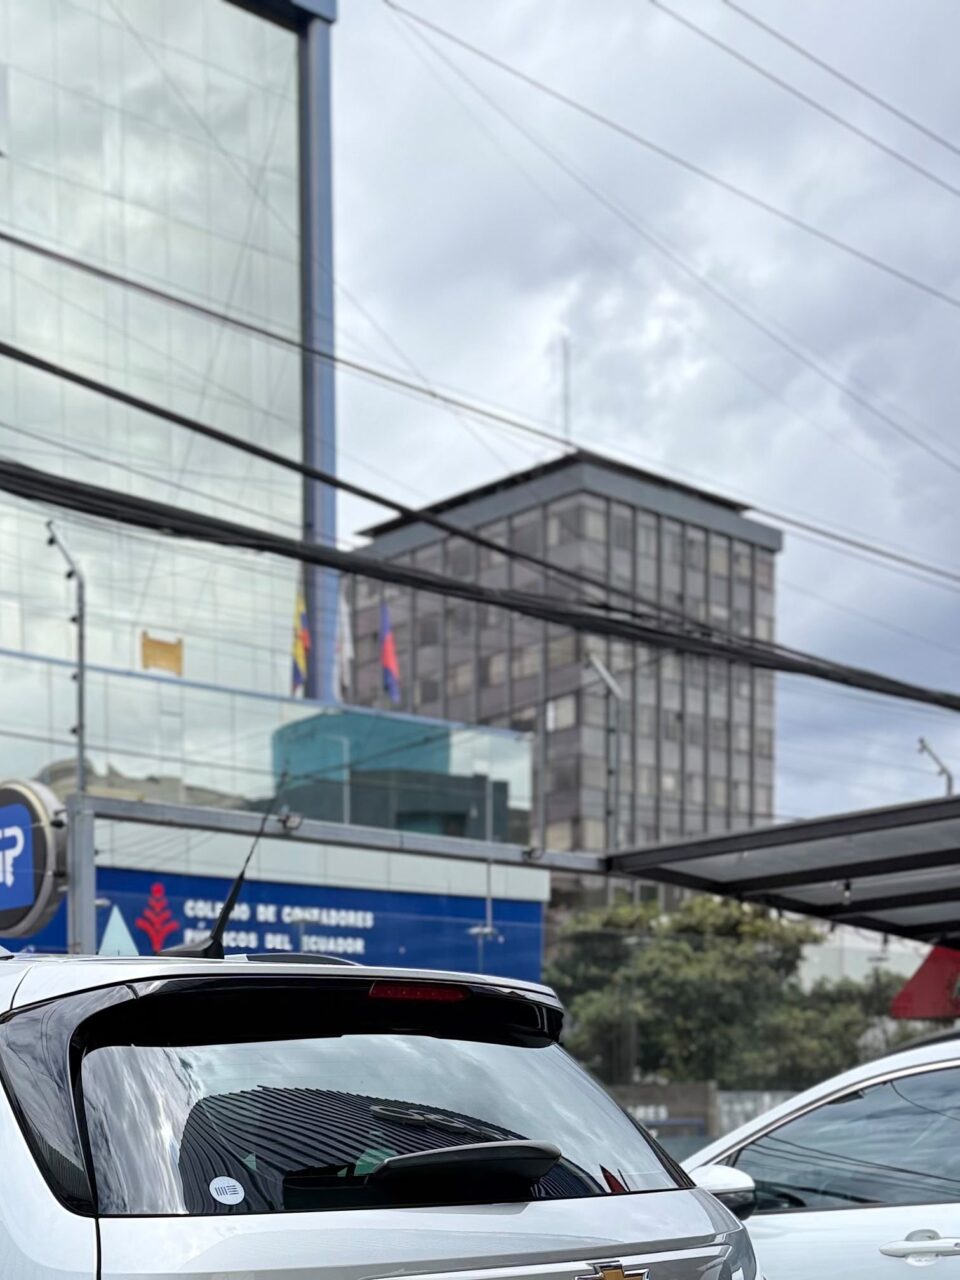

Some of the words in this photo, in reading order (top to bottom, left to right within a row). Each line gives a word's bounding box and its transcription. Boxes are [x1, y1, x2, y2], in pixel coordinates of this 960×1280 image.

[183, 899, 251, 922] COLEIO
[256, 904, 277, 923] DE
[281, 905, 375, 929] CONTADORES
[264, 932, 293, 950] DEL
